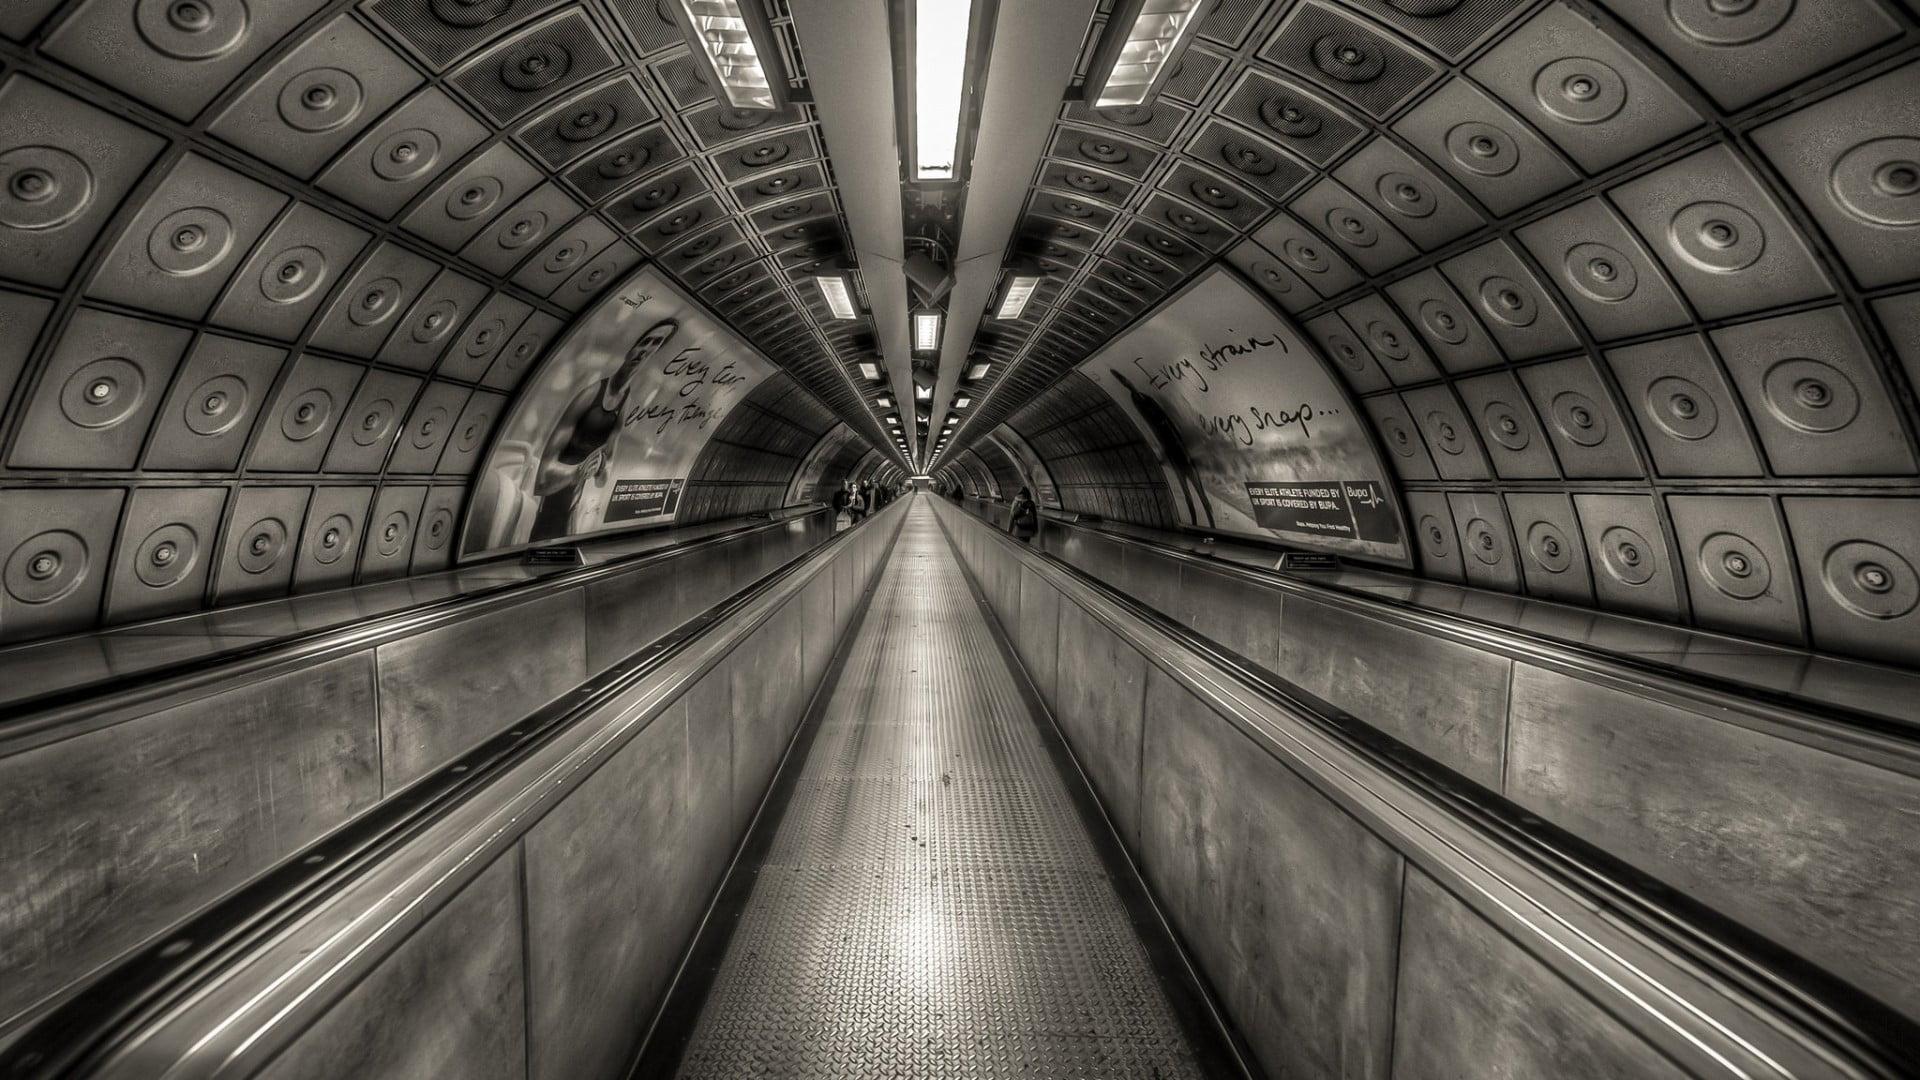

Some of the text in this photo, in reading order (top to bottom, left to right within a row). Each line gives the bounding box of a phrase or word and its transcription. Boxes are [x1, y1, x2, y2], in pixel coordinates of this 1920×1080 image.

[1134, 357, 1209, 392] Every
[1199, 414, 1254, 446] every
[1264, 488, 1279, 497] ELITE
[1280, 488, 1303, 497] ATHLETE
[1303, 488, 1330, 498] FUNDED
[1330, 488, 1340, 498] BY
[1347, 486, 1368, 498] Bupa
[1282, 499, 1309, 509] COVERED
[1309, 501, 1317, 510] BY
